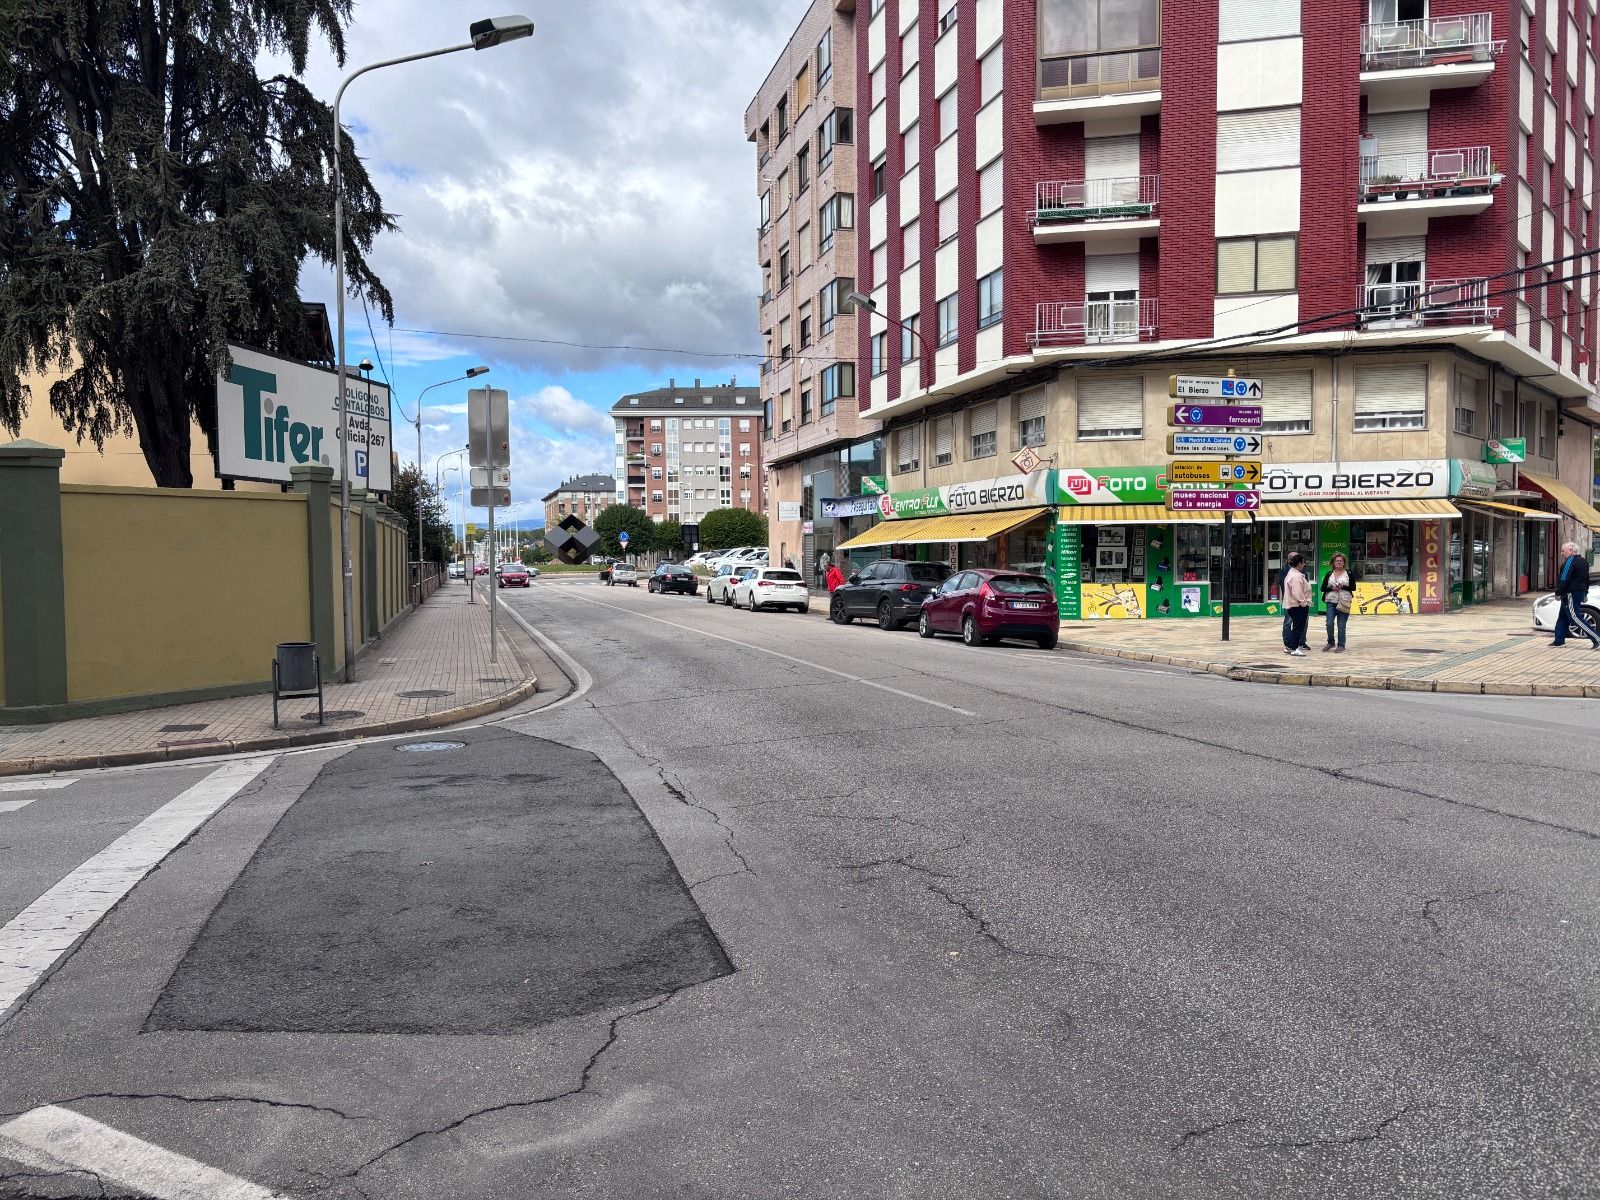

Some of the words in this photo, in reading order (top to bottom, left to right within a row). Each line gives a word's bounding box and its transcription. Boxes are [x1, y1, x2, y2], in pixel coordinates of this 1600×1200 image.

[344, 387, 379, 405] OLÍGONO
[1189, 386, 1209, 394] Bierzo
[335, 396, 385, 417] CNTALOBOS
[349, 416, 373, 432] Avda.
[336, 427, 370, 447] Glicia,
[371, 433, 386, 447] 267
[1097, 475, 1147, 491] FOTO
[1331, 472, 1434, 489] BIERZO
[949, 490, 977, 508] FOTO
[980, 484, 1025, 505] BIERZO
